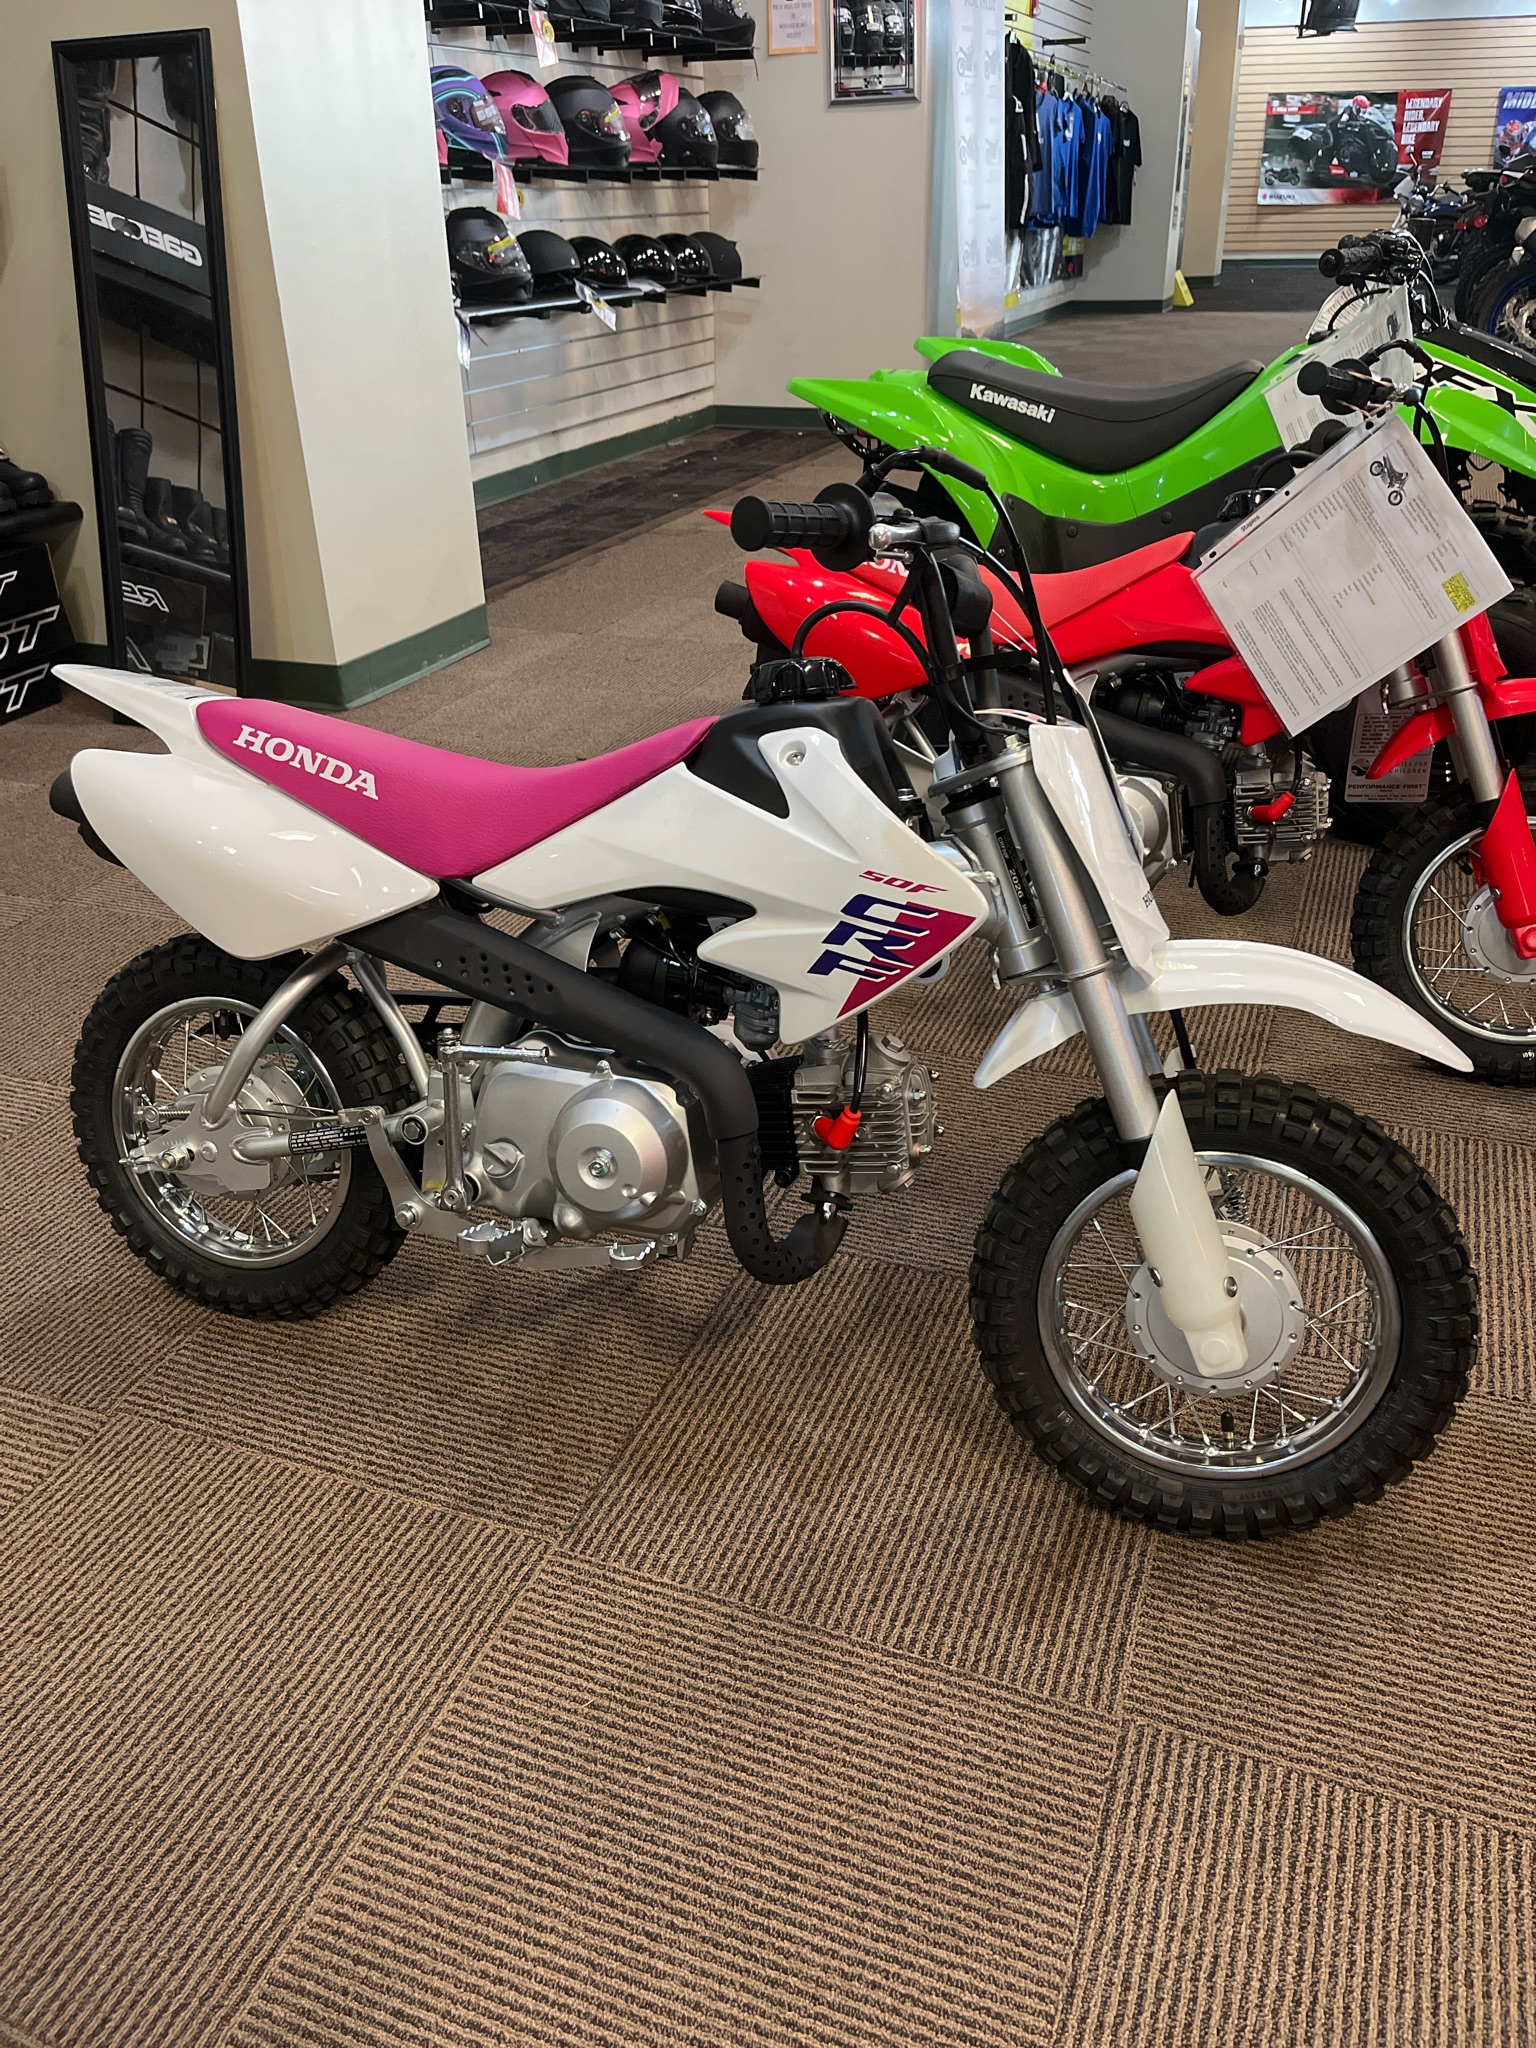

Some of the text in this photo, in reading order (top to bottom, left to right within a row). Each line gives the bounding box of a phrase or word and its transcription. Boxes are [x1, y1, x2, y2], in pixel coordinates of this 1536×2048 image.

[1405, 97, 1443, 109] LEGENDARY
[1401, 133, 1416, 145] BIKE
[1403, 121, 1440, 133] LEGENDARY
[970, 383, 1056, 424] Kawasaki
[233, 724, 379, 801] HONDA
[858, 869, 949, 893] 50F
[1009, 868, 1024, 899] 2026
[1022, 904, 1032, 922] Model
[807, 893, 939, 982] CRF
